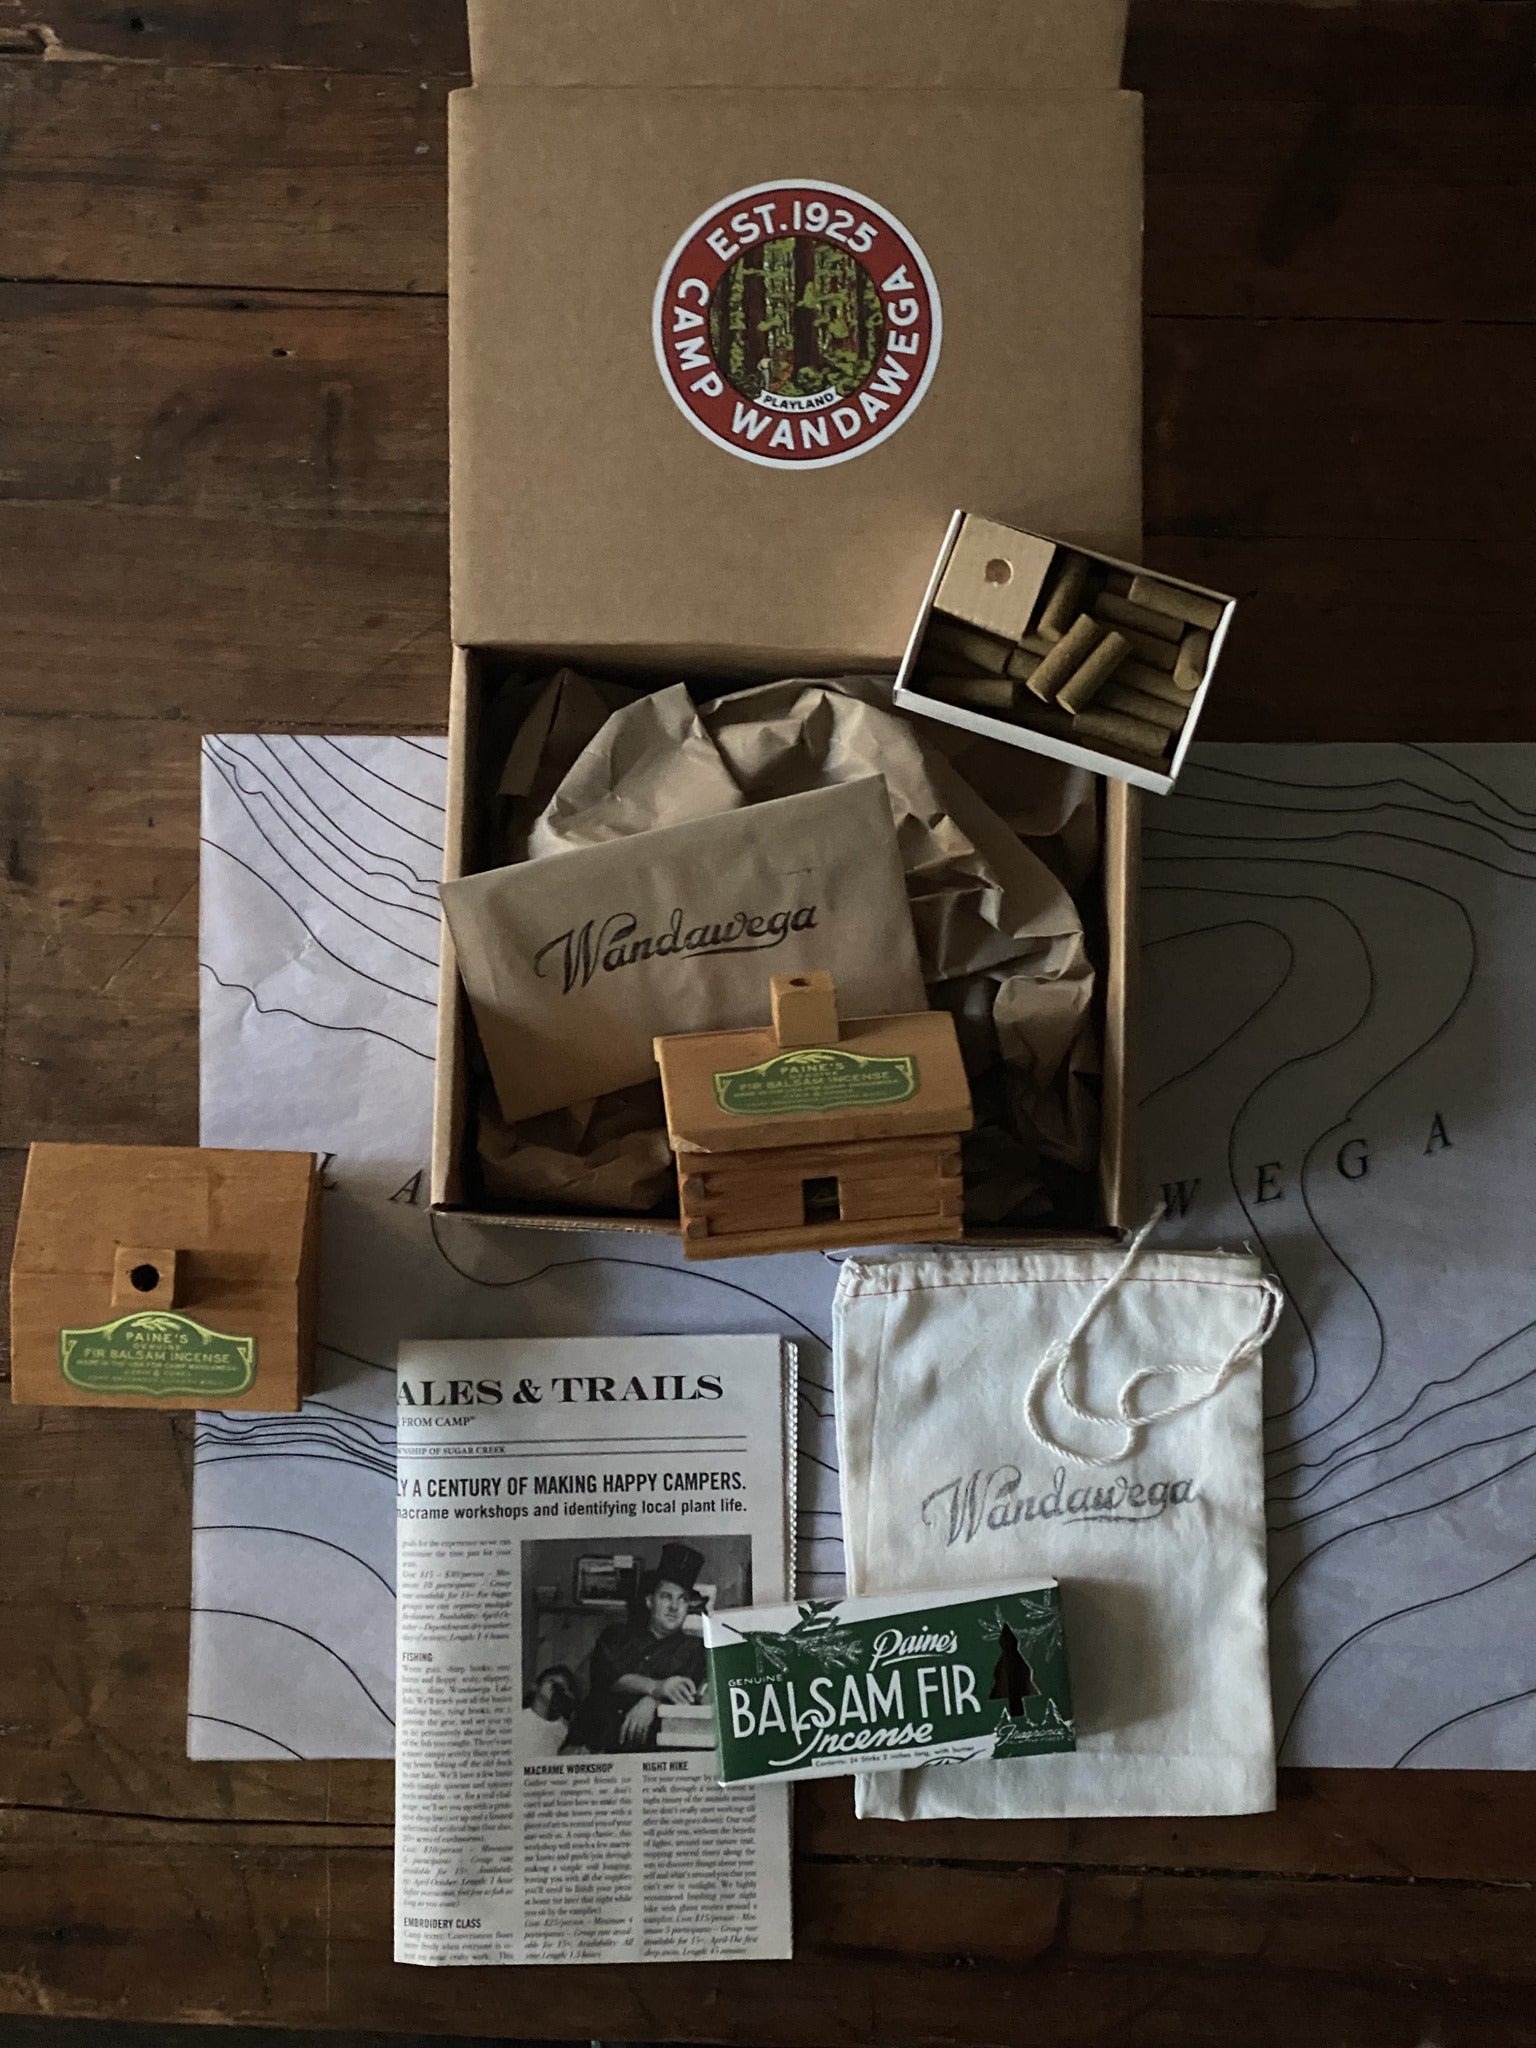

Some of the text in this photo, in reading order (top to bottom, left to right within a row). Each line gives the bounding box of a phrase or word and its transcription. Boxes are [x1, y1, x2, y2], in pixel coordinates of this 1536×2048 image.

[673, 278, 724, 398] CAMP
[731, 264, 920, 450] WANDAWEGA
[763, 393, 835, 409] PLAYLAND
[533, 905, 819, 995] Wandawega
[781, 1062, 844, 1075] PAINE'S
[766, 1078, 824, 1089] BALSAM
[828, 1071, 889, 1083] INCENSE
[125, 1331, 189, 1344] PAINE'S
[84, 1348, 231, 1364] FIR BALSAM INCENSE
[512, 1379, 543, 1405] &
[551, 1374, 724, 1403] TRAILS
[402, 1416, 432, 1427] FROM
[429, 1447, 441, 1455] OF
[443, 1446, 474, 1455] SUGAR
[475, 1446, 507, 1454] CREEK
[397, 1471, 747, 1498] Y A CENTURY OF MAKING HAPPY CAMPERS.
[454, 1503, 529, 1521] workshops
[534, 1502, 559, 1517] and
[564, 1500, 637, 1517] identifying
[642, 1499, 676, 1514] local
[681, 1499, 716, 1516] plant
[720, 1498, 748, 1513] life.
[921, 1464, 1197, 1548] Wandawega
[402, 1652, 433, 1662] FISHING
[868, 1625, 958, 1672] Paine's
[728, 1673, 785, 1687] GENUINE
[730, 1664, 982, 1738] BALSAM FIR
[768, 1709, 934, 1766] Incense
[523, 1763, 613, 1776] MACRAME WORKSHOP
[642, 1761, 688, 1772] NIGHT HIKE
[403, 1917, 482, 1929] EMBROIDERY CLASS
